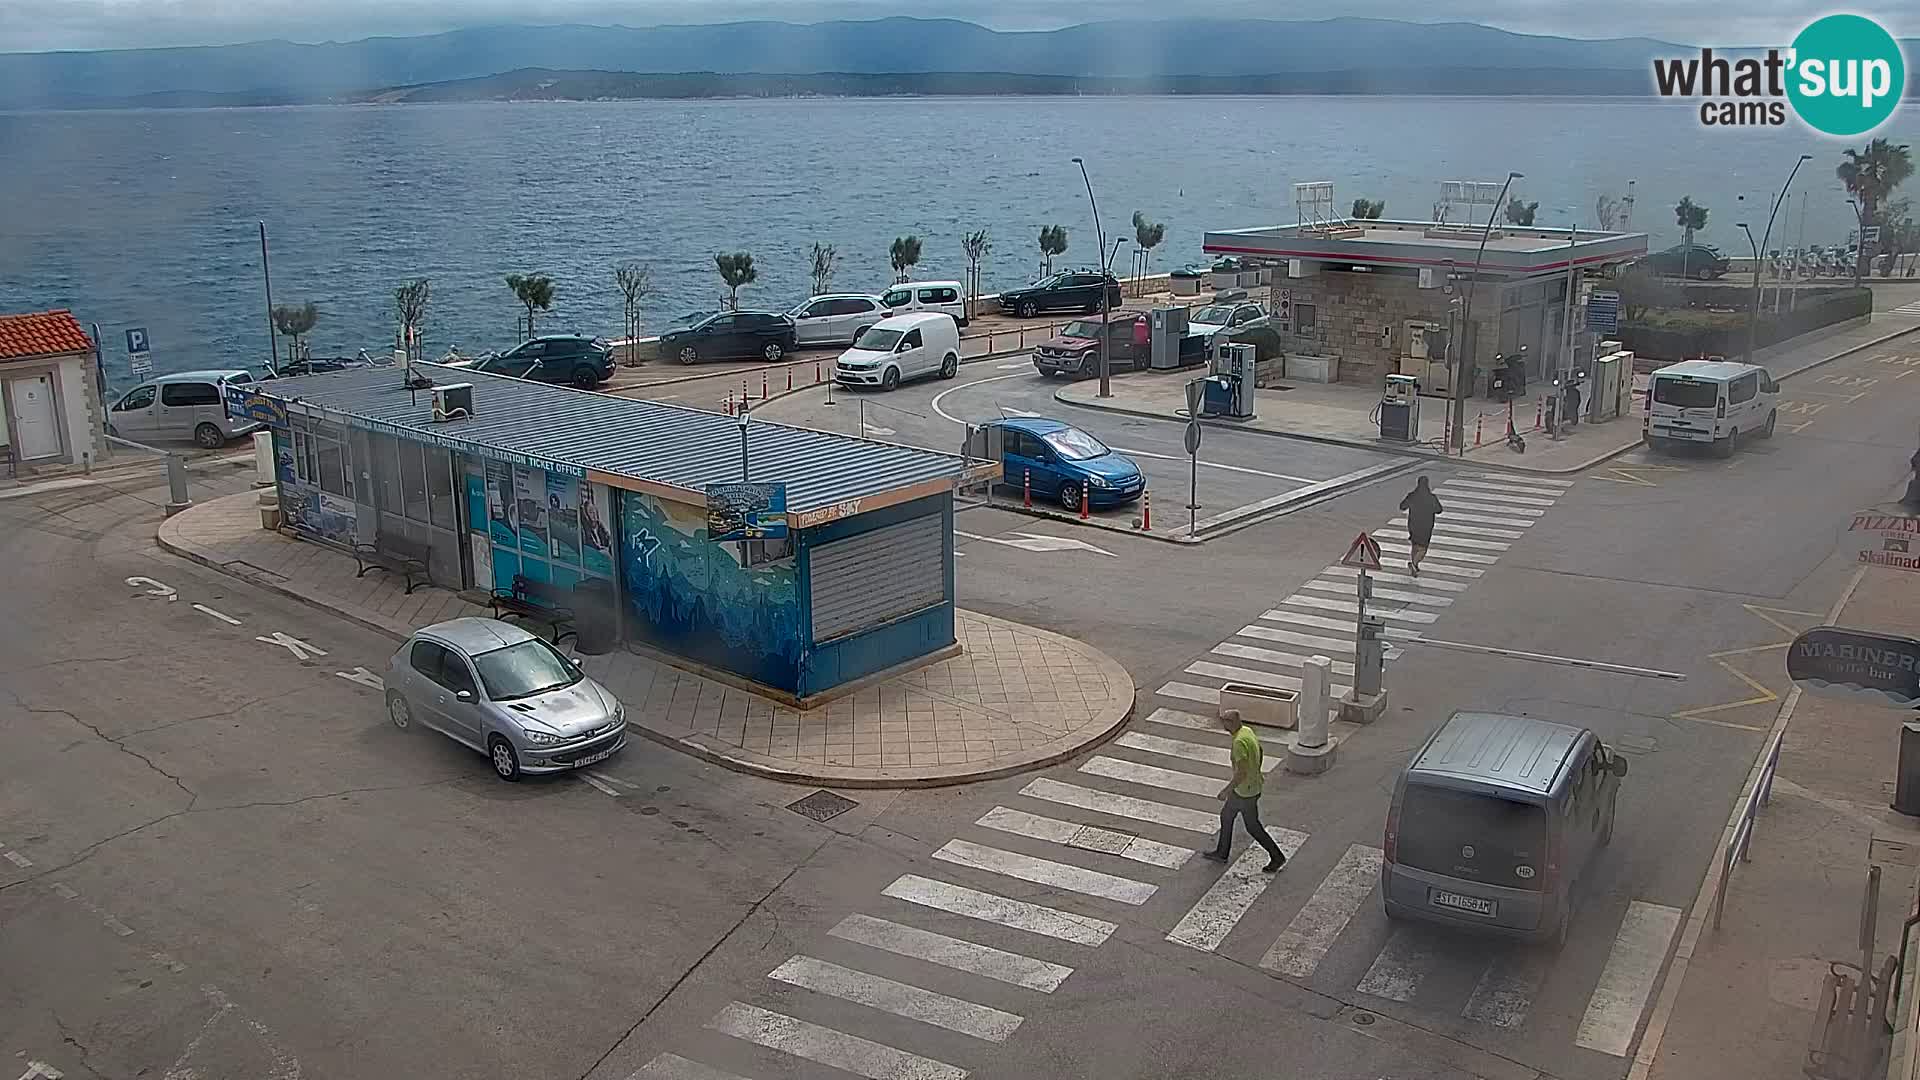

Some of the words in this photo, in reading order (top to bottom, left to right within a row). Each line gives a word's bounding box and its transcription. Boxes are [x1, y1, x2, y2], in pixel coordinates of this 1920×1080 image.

[495, 450, 527, 465] STATION
[528, 457, 555, 471] TICKET
[555, 464, 583, 477] OFFICE
[1847, 516, 1920, 534] PIZZE
